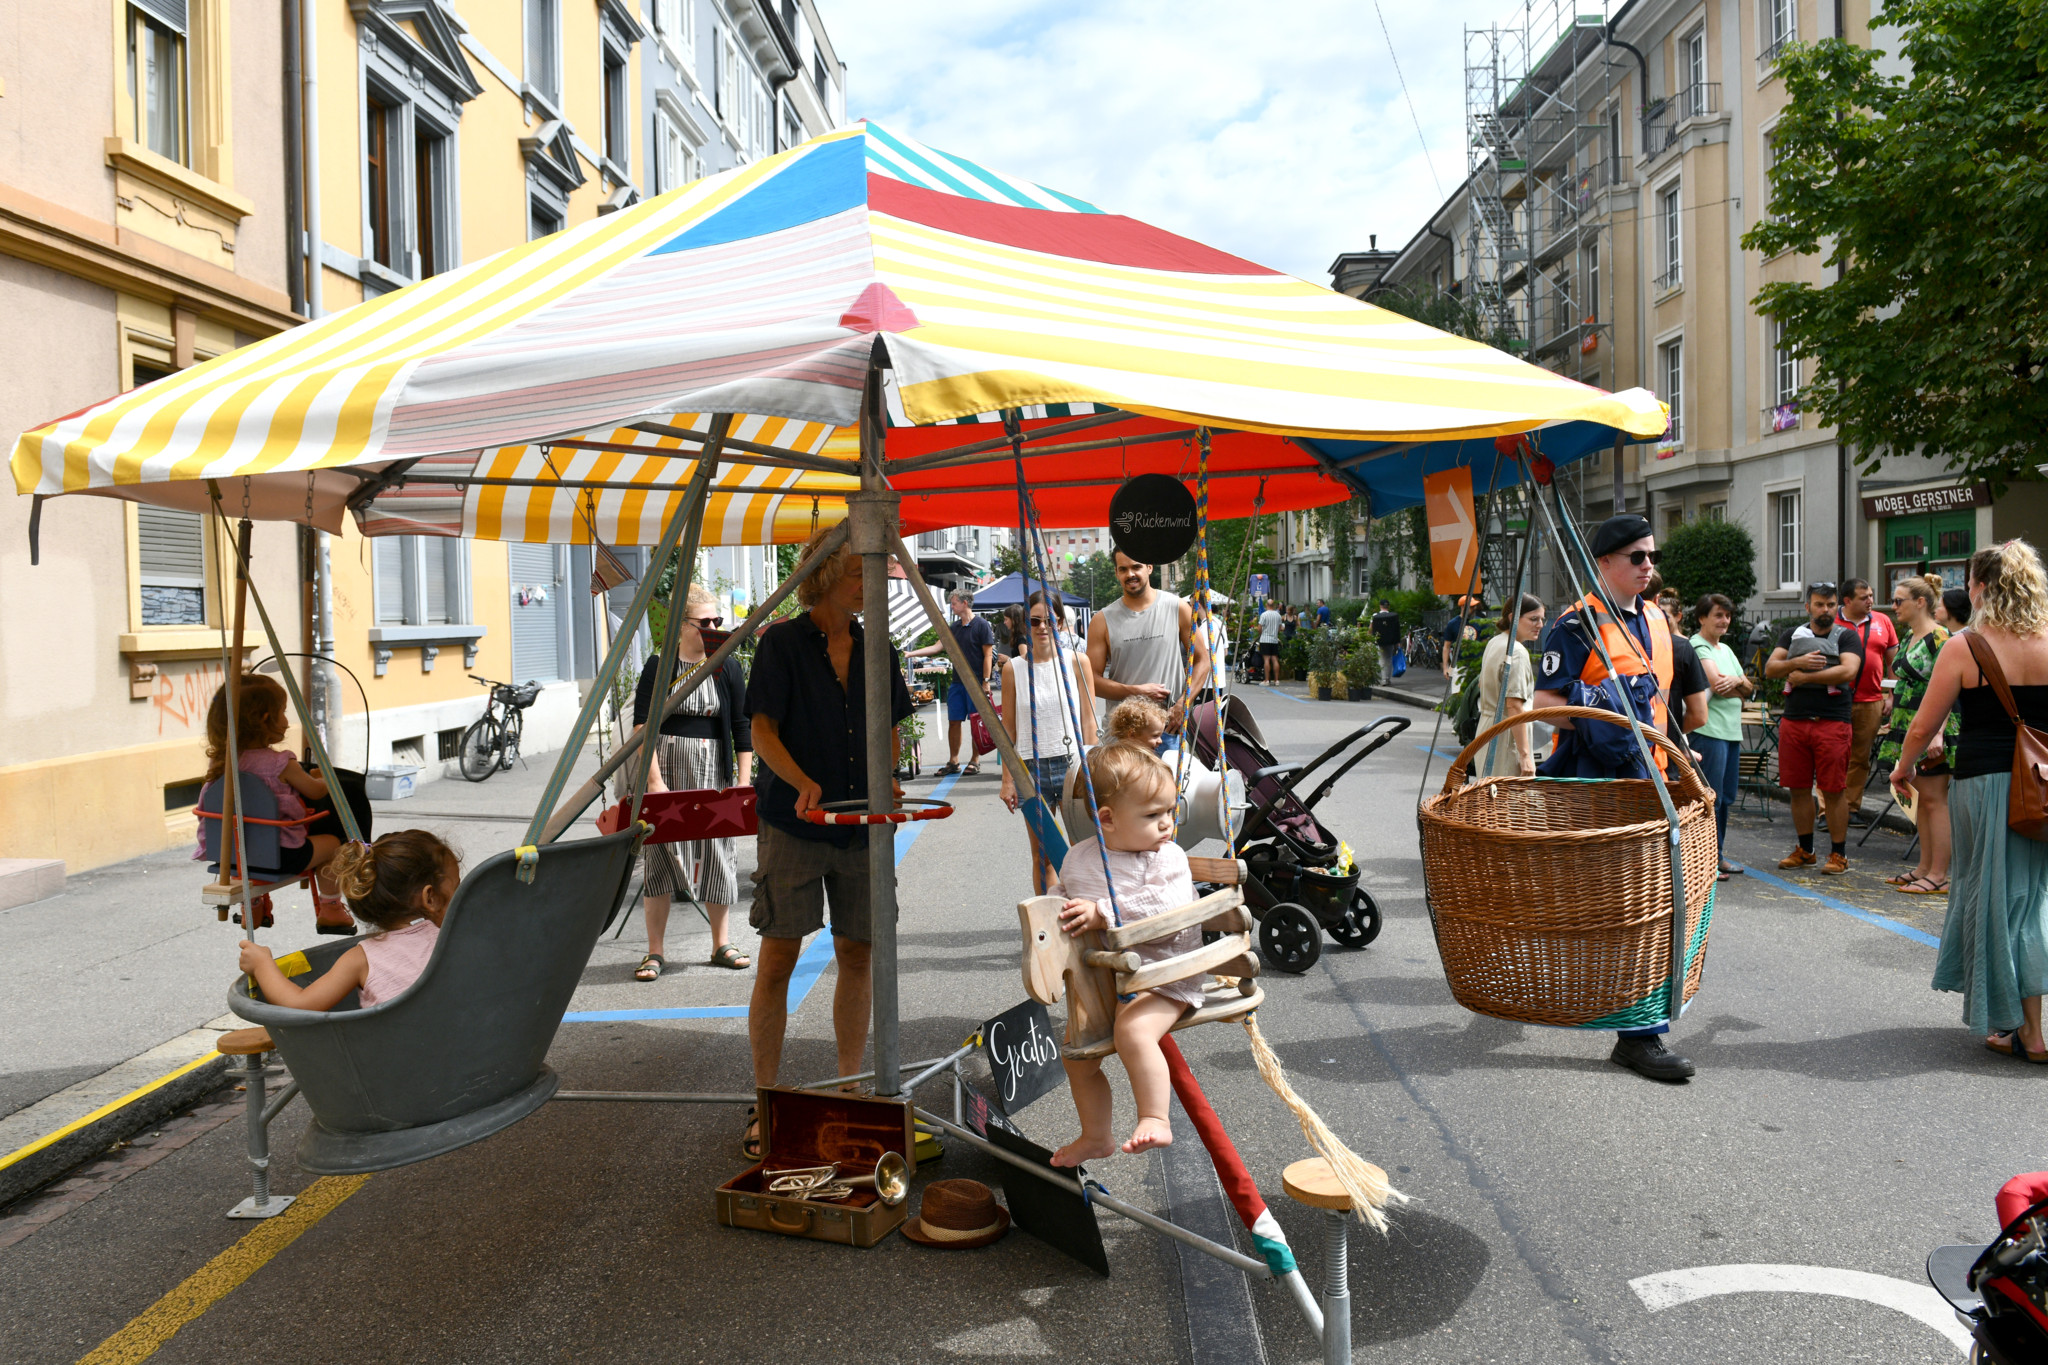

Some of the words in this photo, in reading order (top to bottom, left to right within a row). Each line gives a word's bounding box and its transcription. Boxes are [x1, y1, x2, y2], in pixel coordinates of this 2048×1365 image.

[1875, 496, 1911, 512] MÖBEL
[1912, 487, 1974, 508] GERSTNER
[1134, 510, 1192, 528] Rückenwind
[990, 1016, 1058, 1102] Gratis
